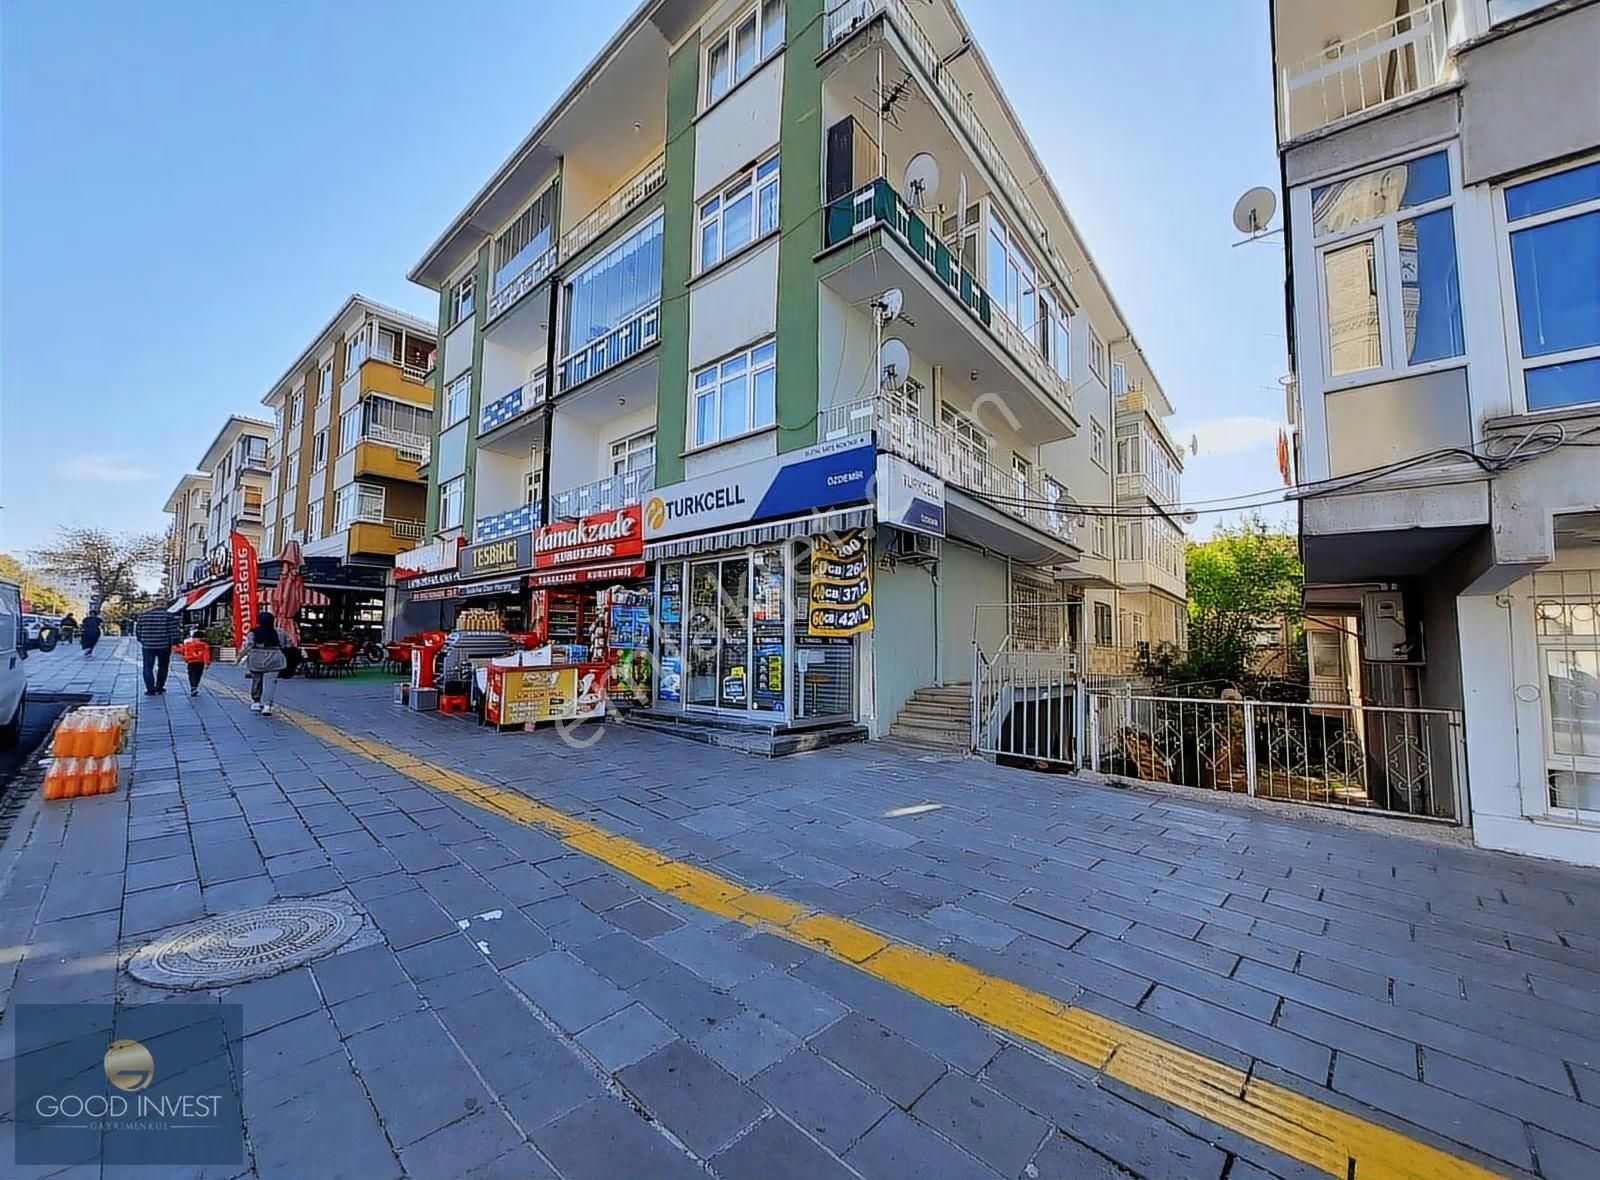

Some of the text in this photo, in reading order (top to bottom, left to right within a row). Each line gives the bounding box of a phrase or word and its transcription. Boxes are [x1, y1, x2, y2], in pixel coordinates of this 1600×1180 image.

[902, 474, 940, 499] TURKCELL
[666, 484, 746, 520] TURKCELL
[535, 509, 635, 552] damakzade
[554, 543, 616, 563] KURUYEMİŞ
